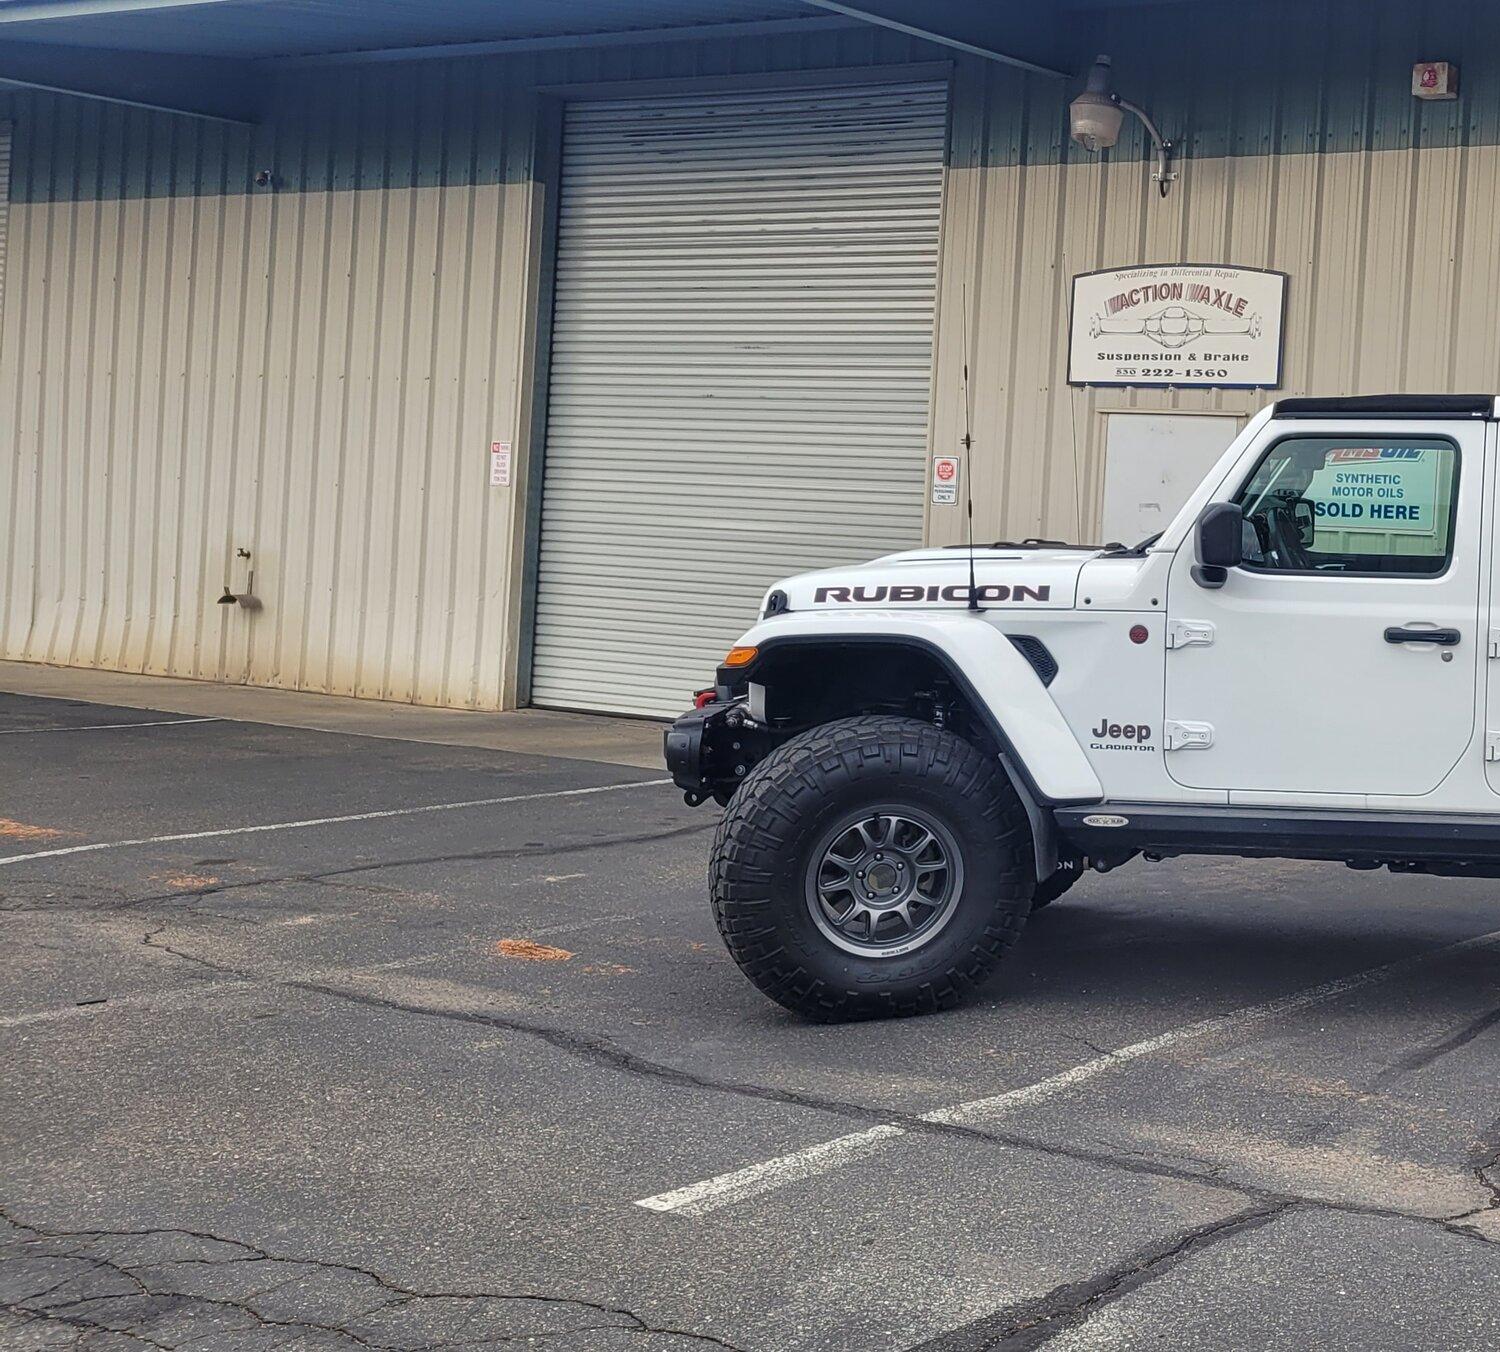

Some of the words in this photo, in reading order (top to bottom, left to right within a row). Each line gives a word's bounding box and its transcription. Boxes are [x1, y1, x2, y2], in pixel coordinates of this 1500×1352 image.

[1114, 269, 1158, 280] Specializing
[1160, 269, 1168, 277] in
[1170, 268, 1212, 277] Differential
[1215, 270, 1240, 279] Repair
[1117, 282, 1184, 311] ACTION
[1197, 285, 1249, 318] AXLE
[1097, 352, 1182, 361] Suspension
[1188, 353, 1197, 361] &
[1203, 353, 1249, 362] Brake
[1141, 369, 1228, 378] 222-1360
[1335, 473, 1401, 485] SYNTHETIC
[1331, 486, 1373, 498] MOTOR
[1377, 488, 1404, 499] OILS
[1314, 502, 1364, 518] SOLD
[1370, 504, 1421, 520] HERE
[813, 584, 1051, 603] RUBICON
[1092, 718, 1152, 743] Jeep
[1090, 743, 1155, 752] GLADIATOR
